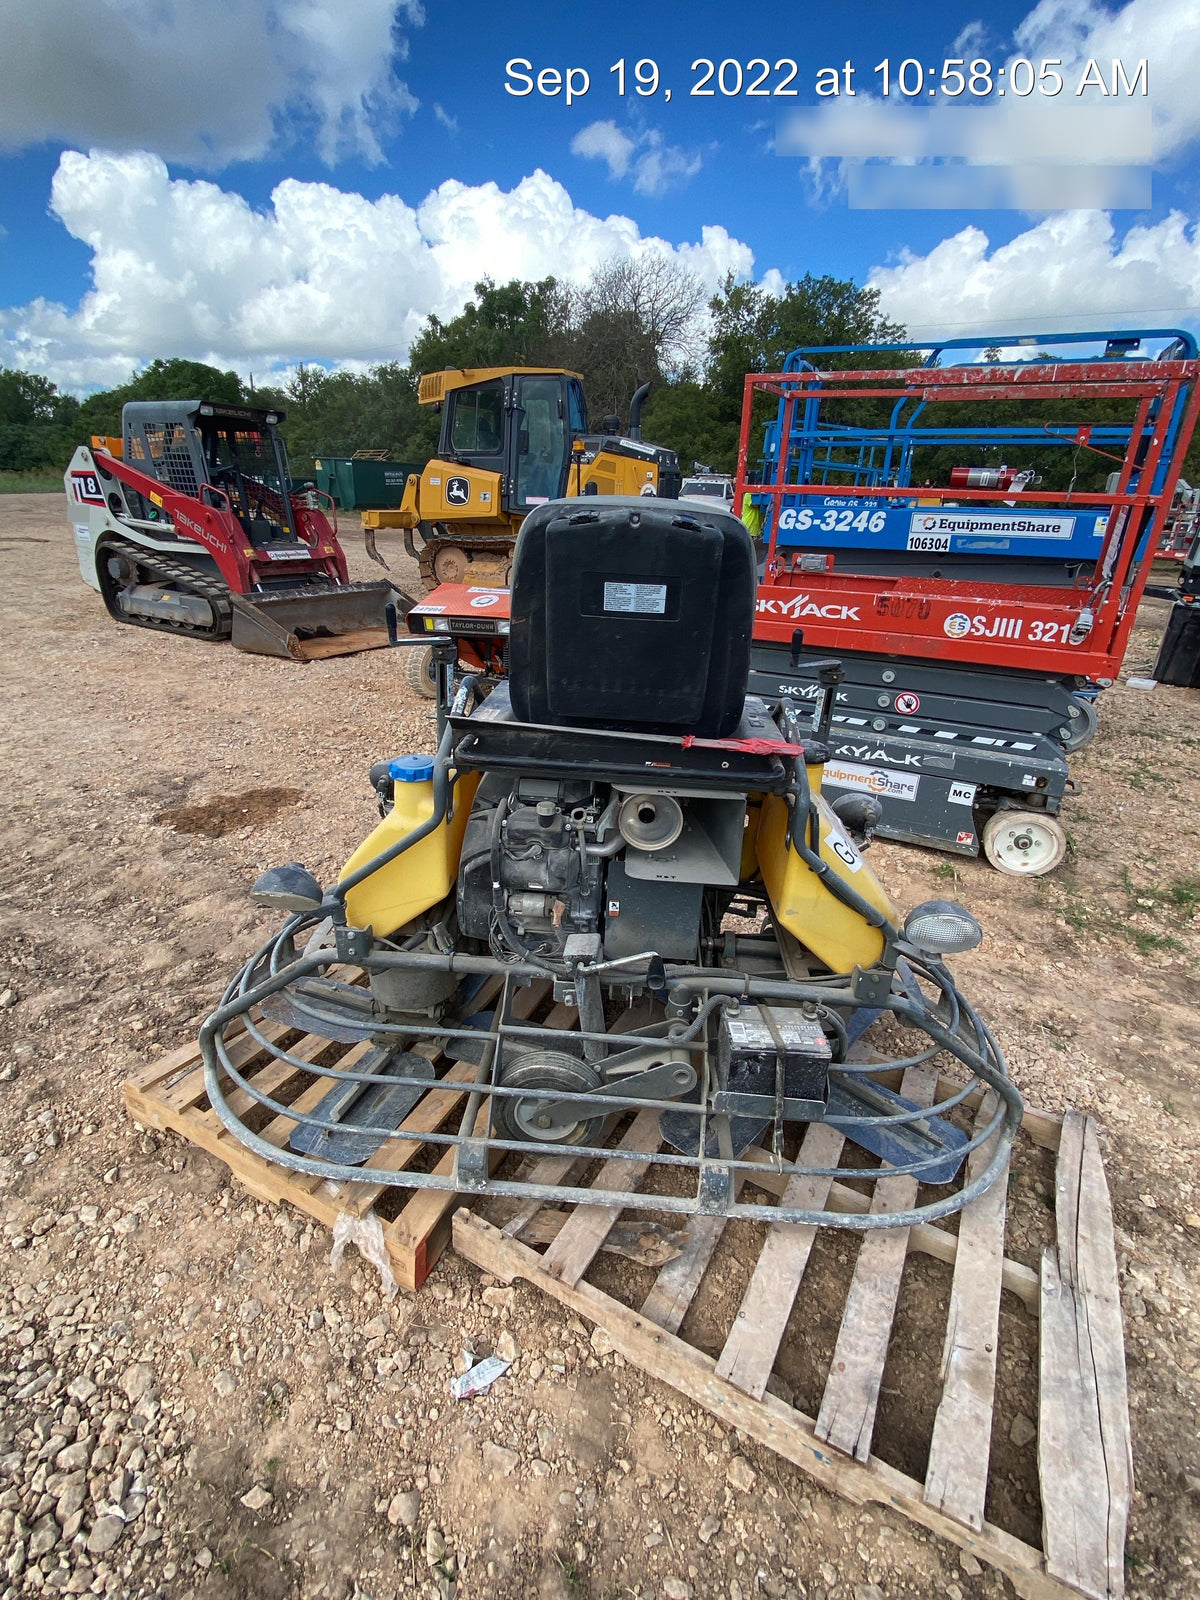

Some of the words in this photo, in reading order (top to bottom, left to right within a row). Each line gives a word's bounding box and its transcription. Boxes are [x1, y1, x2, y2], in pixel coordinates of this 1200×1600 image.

[71, 476, 105, 503] TL8
[778, 508, 887, 533] GS-3246
[938, 517, 1062, 534] EquipmentShare
[909, 536, 949, 552] 106304
[451, 621, 495, 630] TAYLOR-DUNN
[970, 615, 1023, 639] SJIII
[823, 769, 915, 793] quipmentShare
